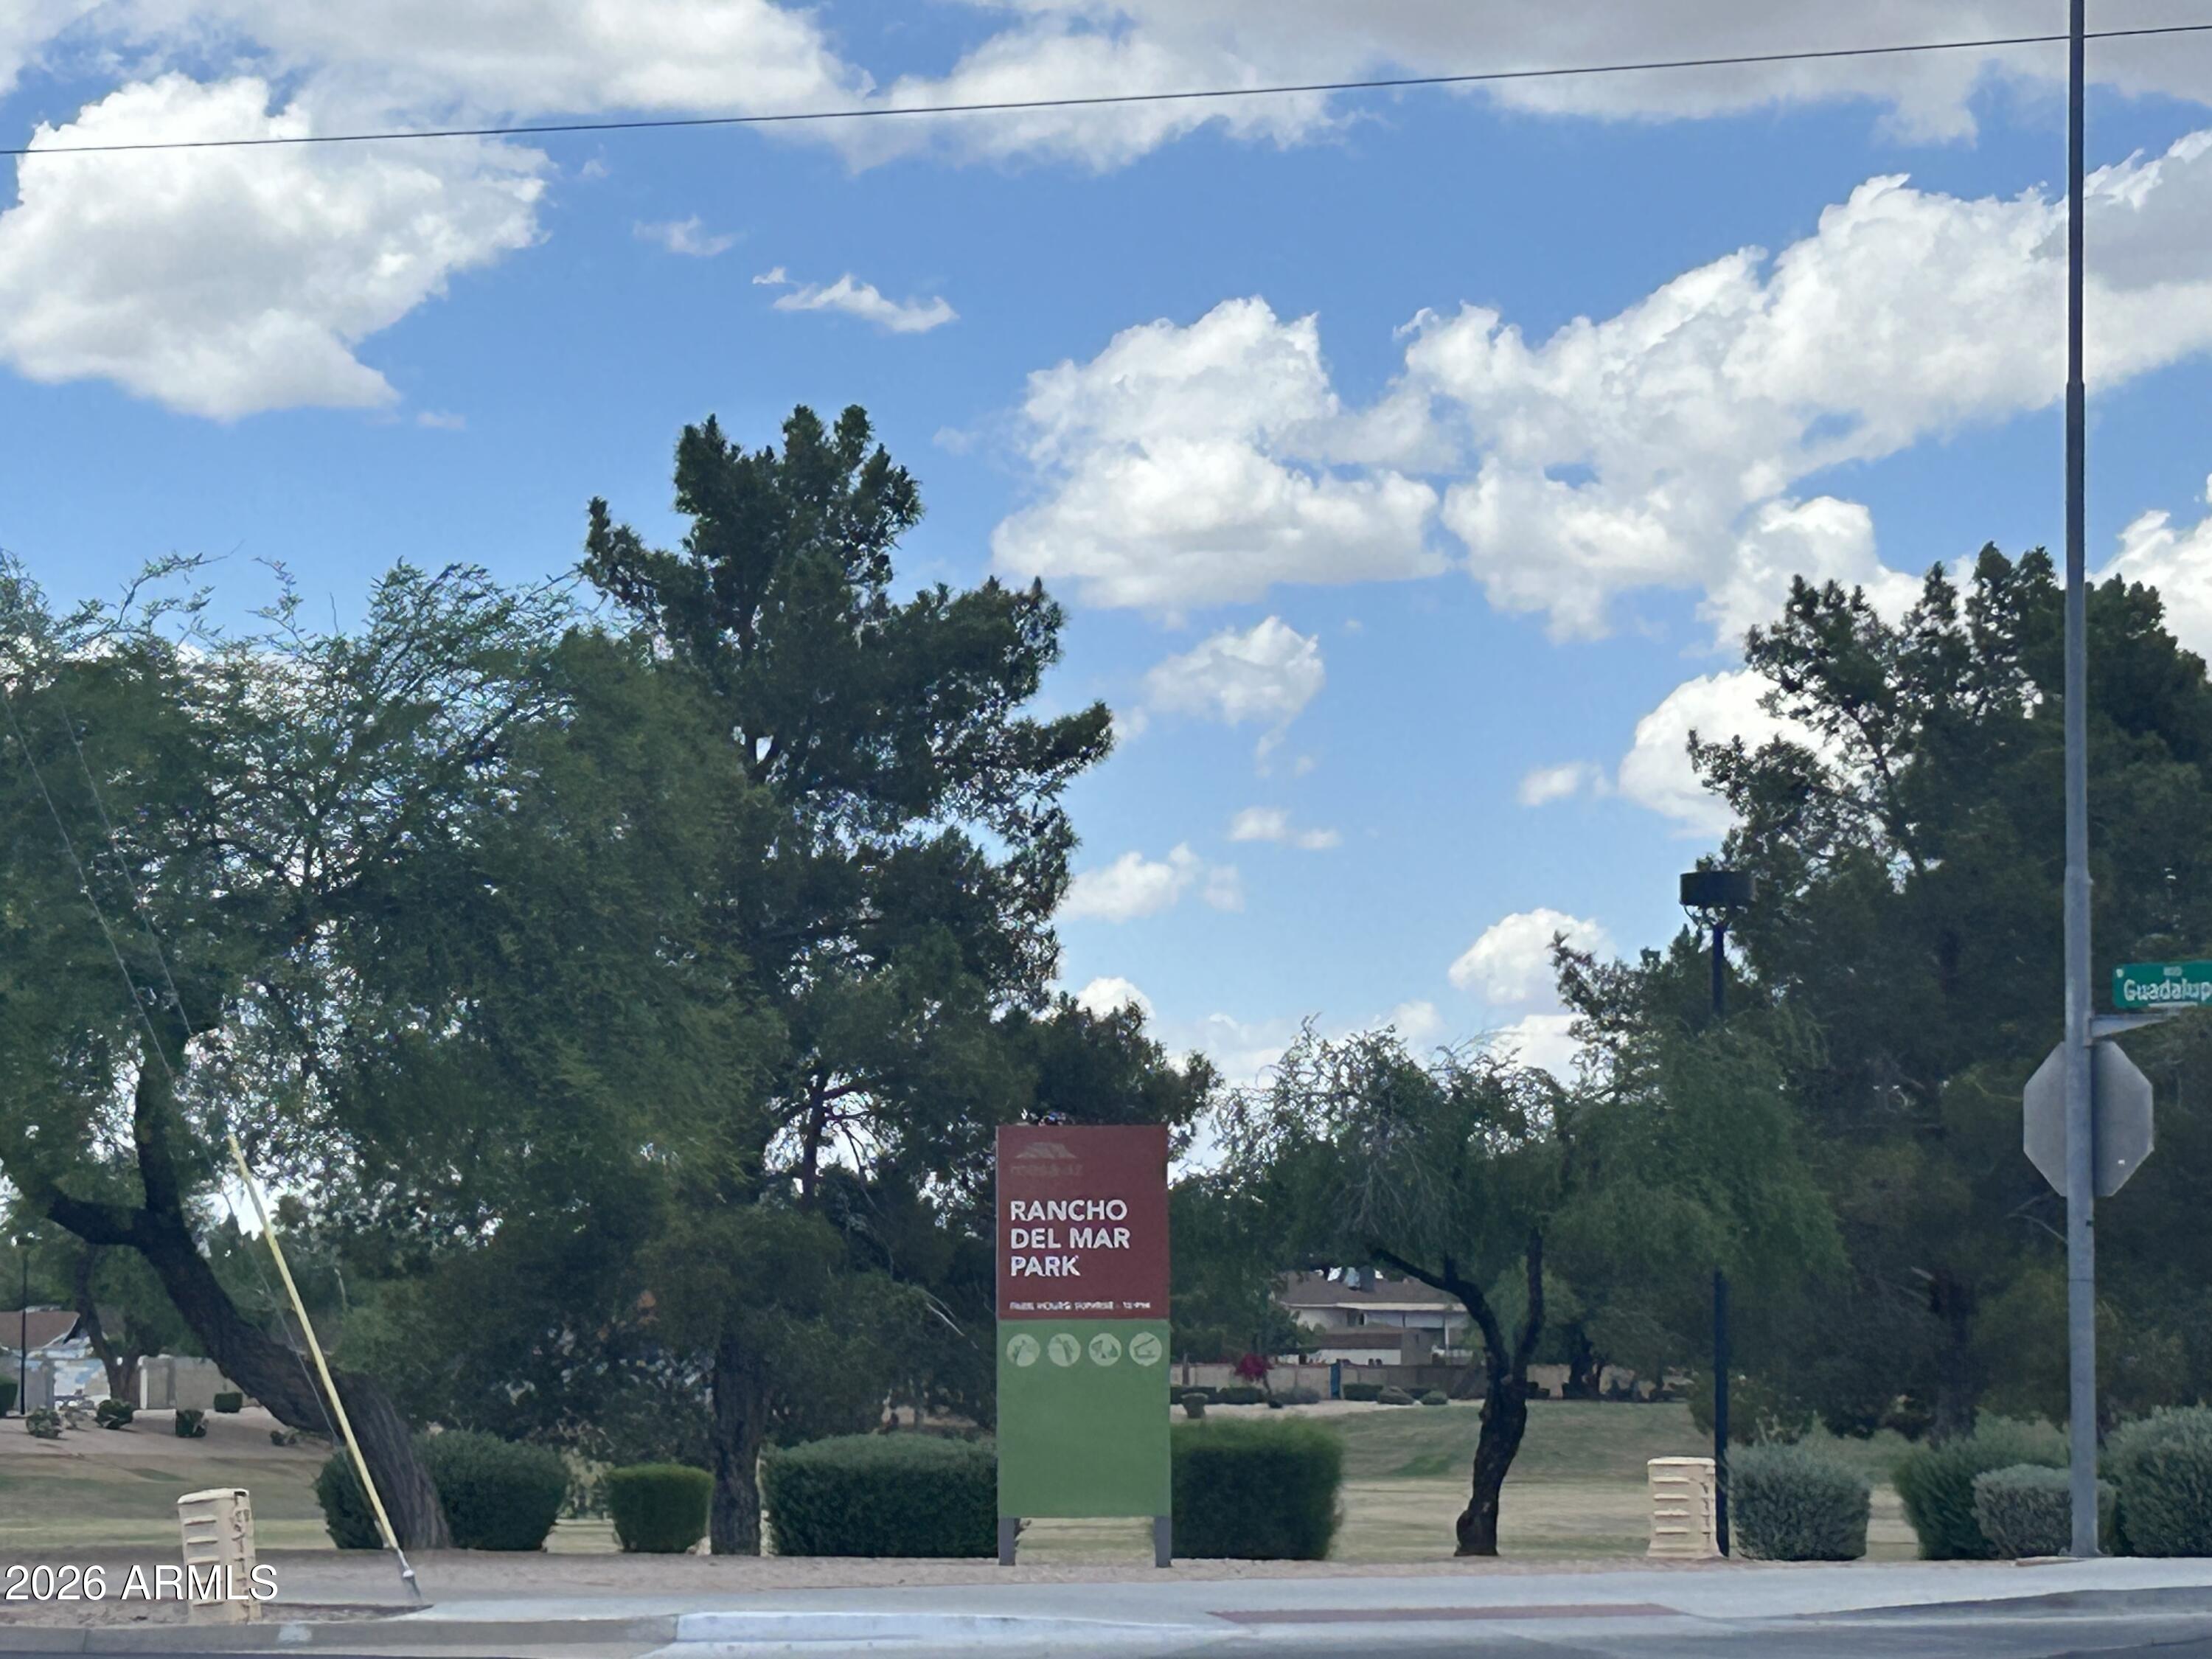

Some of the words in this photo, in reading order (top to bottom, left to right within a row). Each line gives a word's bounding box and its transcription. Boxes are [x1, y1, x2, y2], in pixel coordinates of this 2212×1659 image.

[1010, 1199, 1128, 1222] RANCHO
[1010, 1228, 1062, 1249] DEL
[1069, 1228, 1130, 1249] MAR
[1010, 1255, 1081, 1277] PARK
